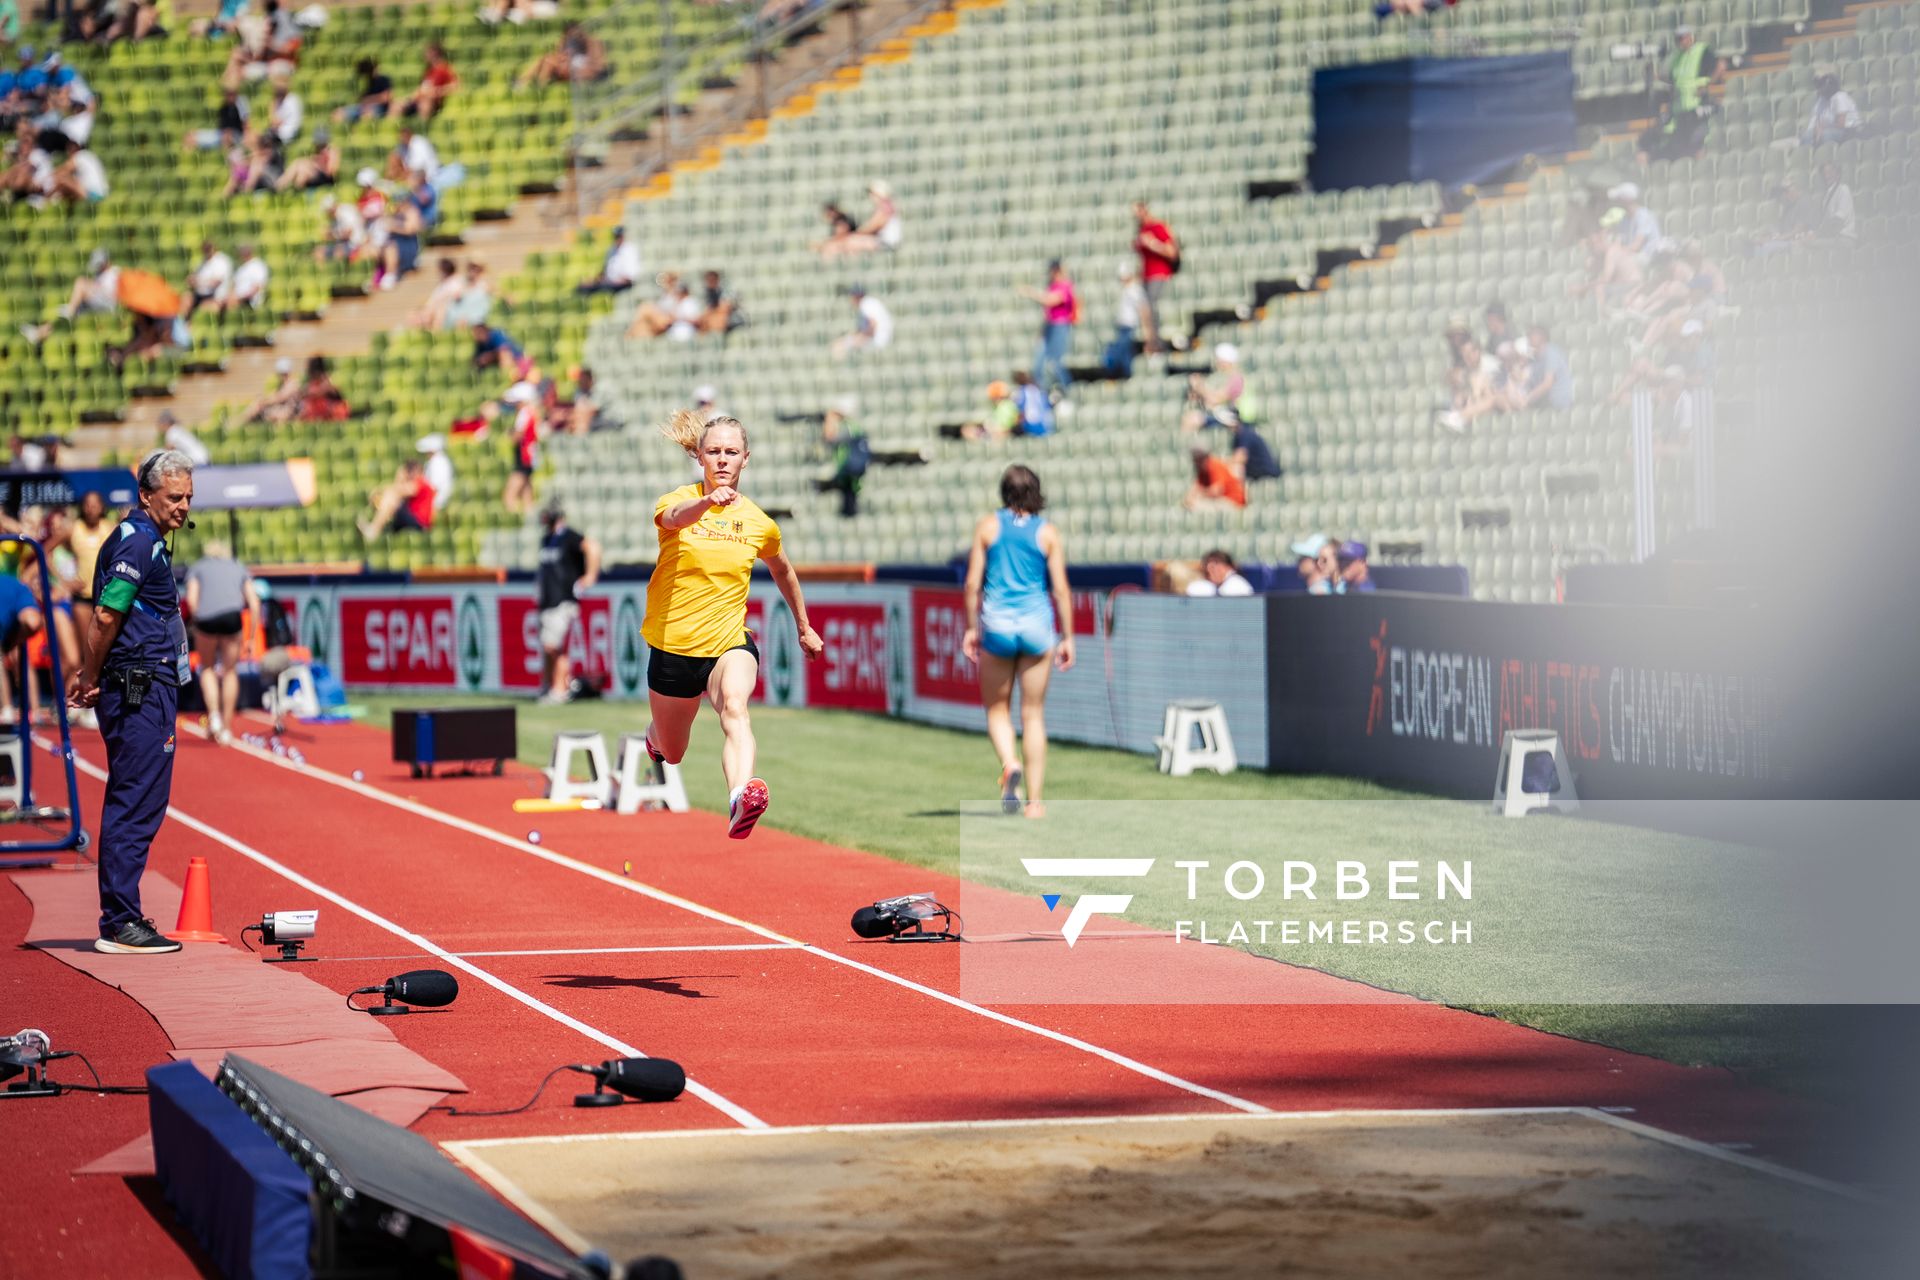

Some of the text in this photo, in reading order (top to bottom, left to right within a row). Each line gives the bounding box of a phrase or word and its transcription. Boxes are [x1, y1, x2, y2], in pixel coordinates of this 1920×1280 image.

[365, 608, 453, 671] SPAR
[523, 609, 611, 675] SAR
[824, 617, 885, 691] SPAR
[1390, 645, 1492, 749] EUROPEAN
[1499, 658, 1602, 761] ATHLETICS
